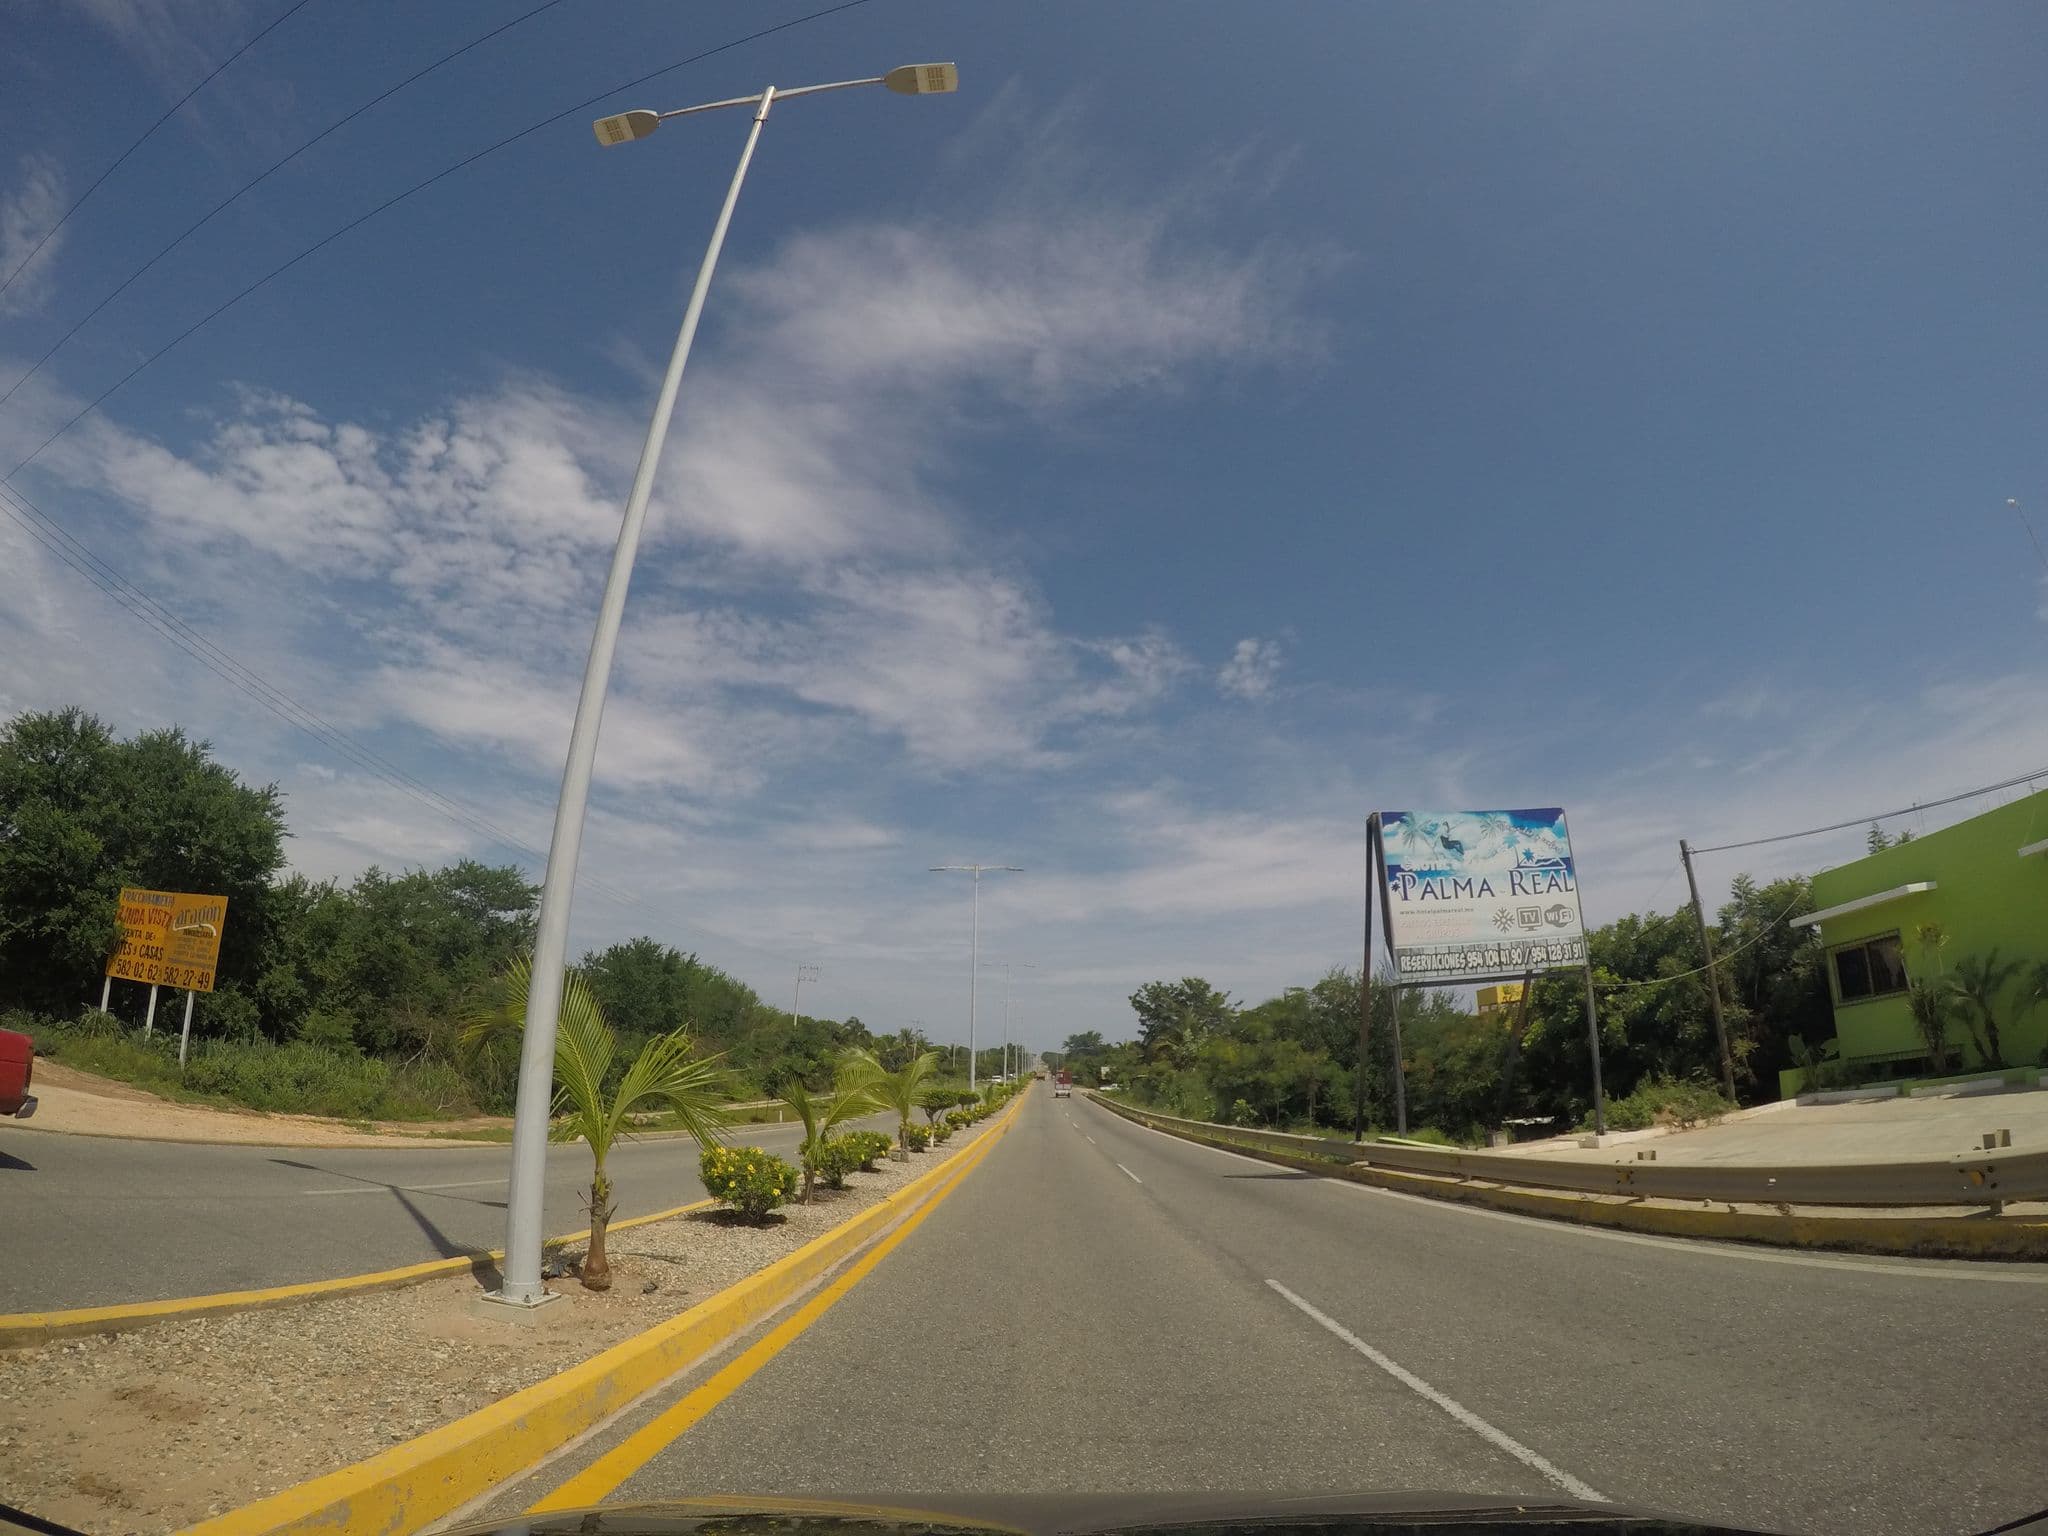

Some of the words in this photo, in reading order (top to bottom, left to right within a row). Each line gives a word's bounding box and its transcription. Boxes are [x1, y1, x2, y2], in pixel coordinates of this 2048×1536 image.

[1398, 872, 1495, 901] PALMA
[1509, 869, 1574, 896] REAL
[148, 908, 173, 931] VISTA
[1523, 913, 1537, 921] TV
[139, 943, 164, 961] CASAS
[1400, 951, 1466, 973] RESERVACIONES
[1466, 951, 1483, 968] 954
[1484, 950, 1500, 966] 104
[1500, 949, 1510, 965] 41
[1511, 948, 1523, 964] 90
[1532, 946, 1547, 963] 954
[1548, 944, 1562, 962] 128
[1563, 943, 1573, 960] 31
[1573, 941, 1583, 959] 91
